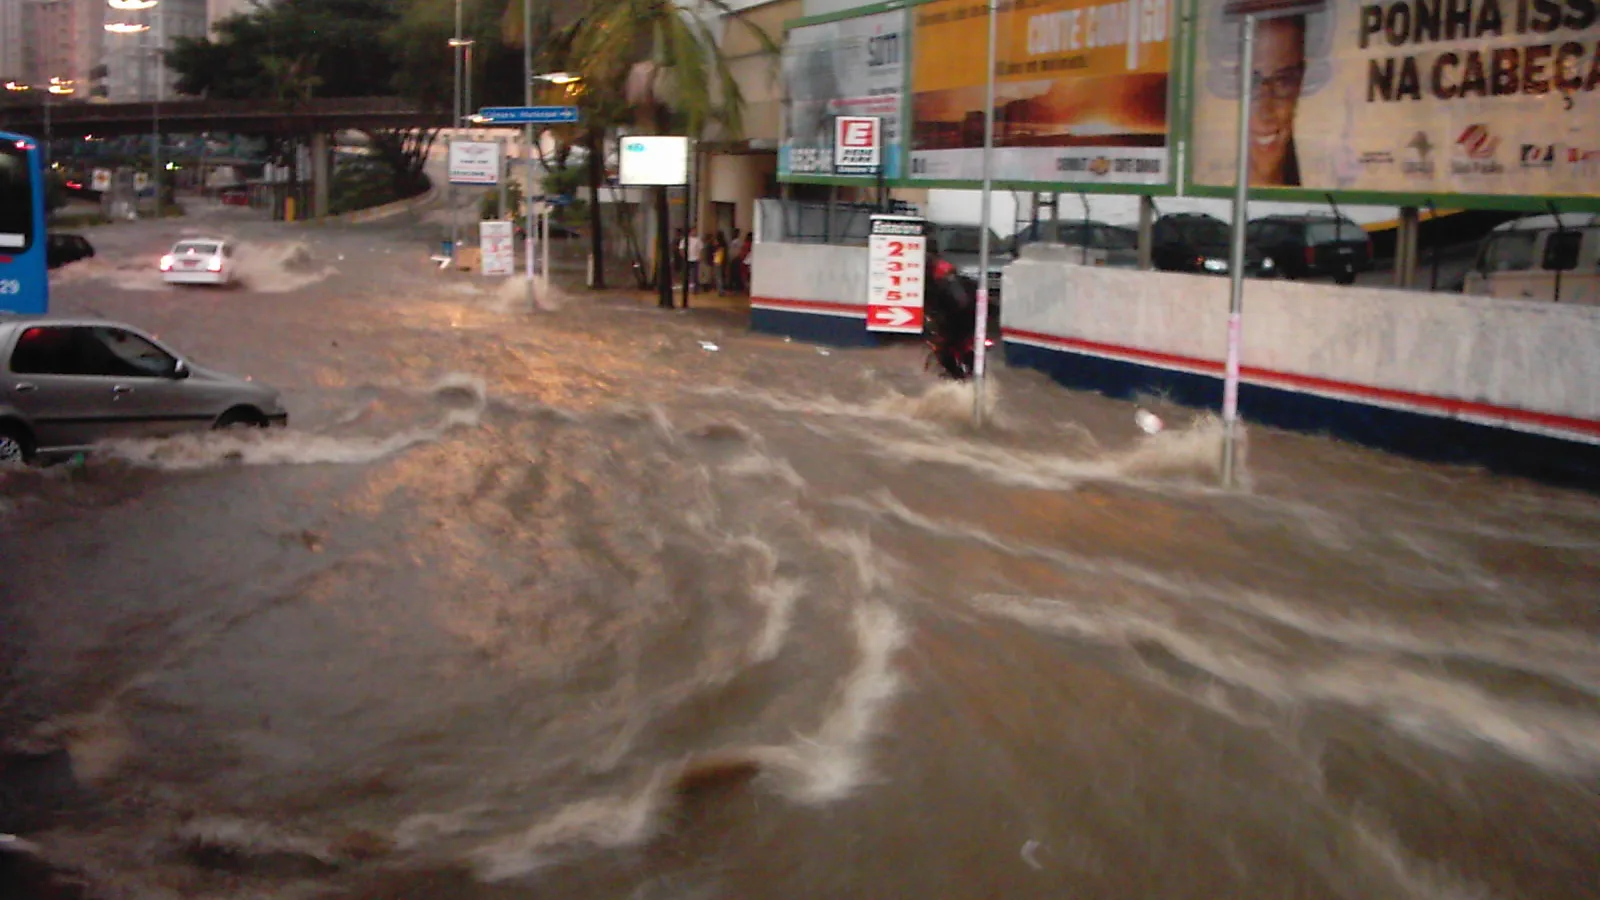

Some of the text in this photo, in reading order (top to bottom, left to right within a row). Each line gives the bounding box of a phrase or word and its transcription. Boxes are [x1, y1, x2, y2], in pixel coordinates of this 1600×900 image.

[1359, 0, 1502, 49] PONHA
[1367, 41, 1600, 110] NA CABEÇA
[888, 241, 904, 257] 2
[887, 261, 903, 272] 3
[890, 276, 901, 286] 1
[887, 291, 902, 301] 5
